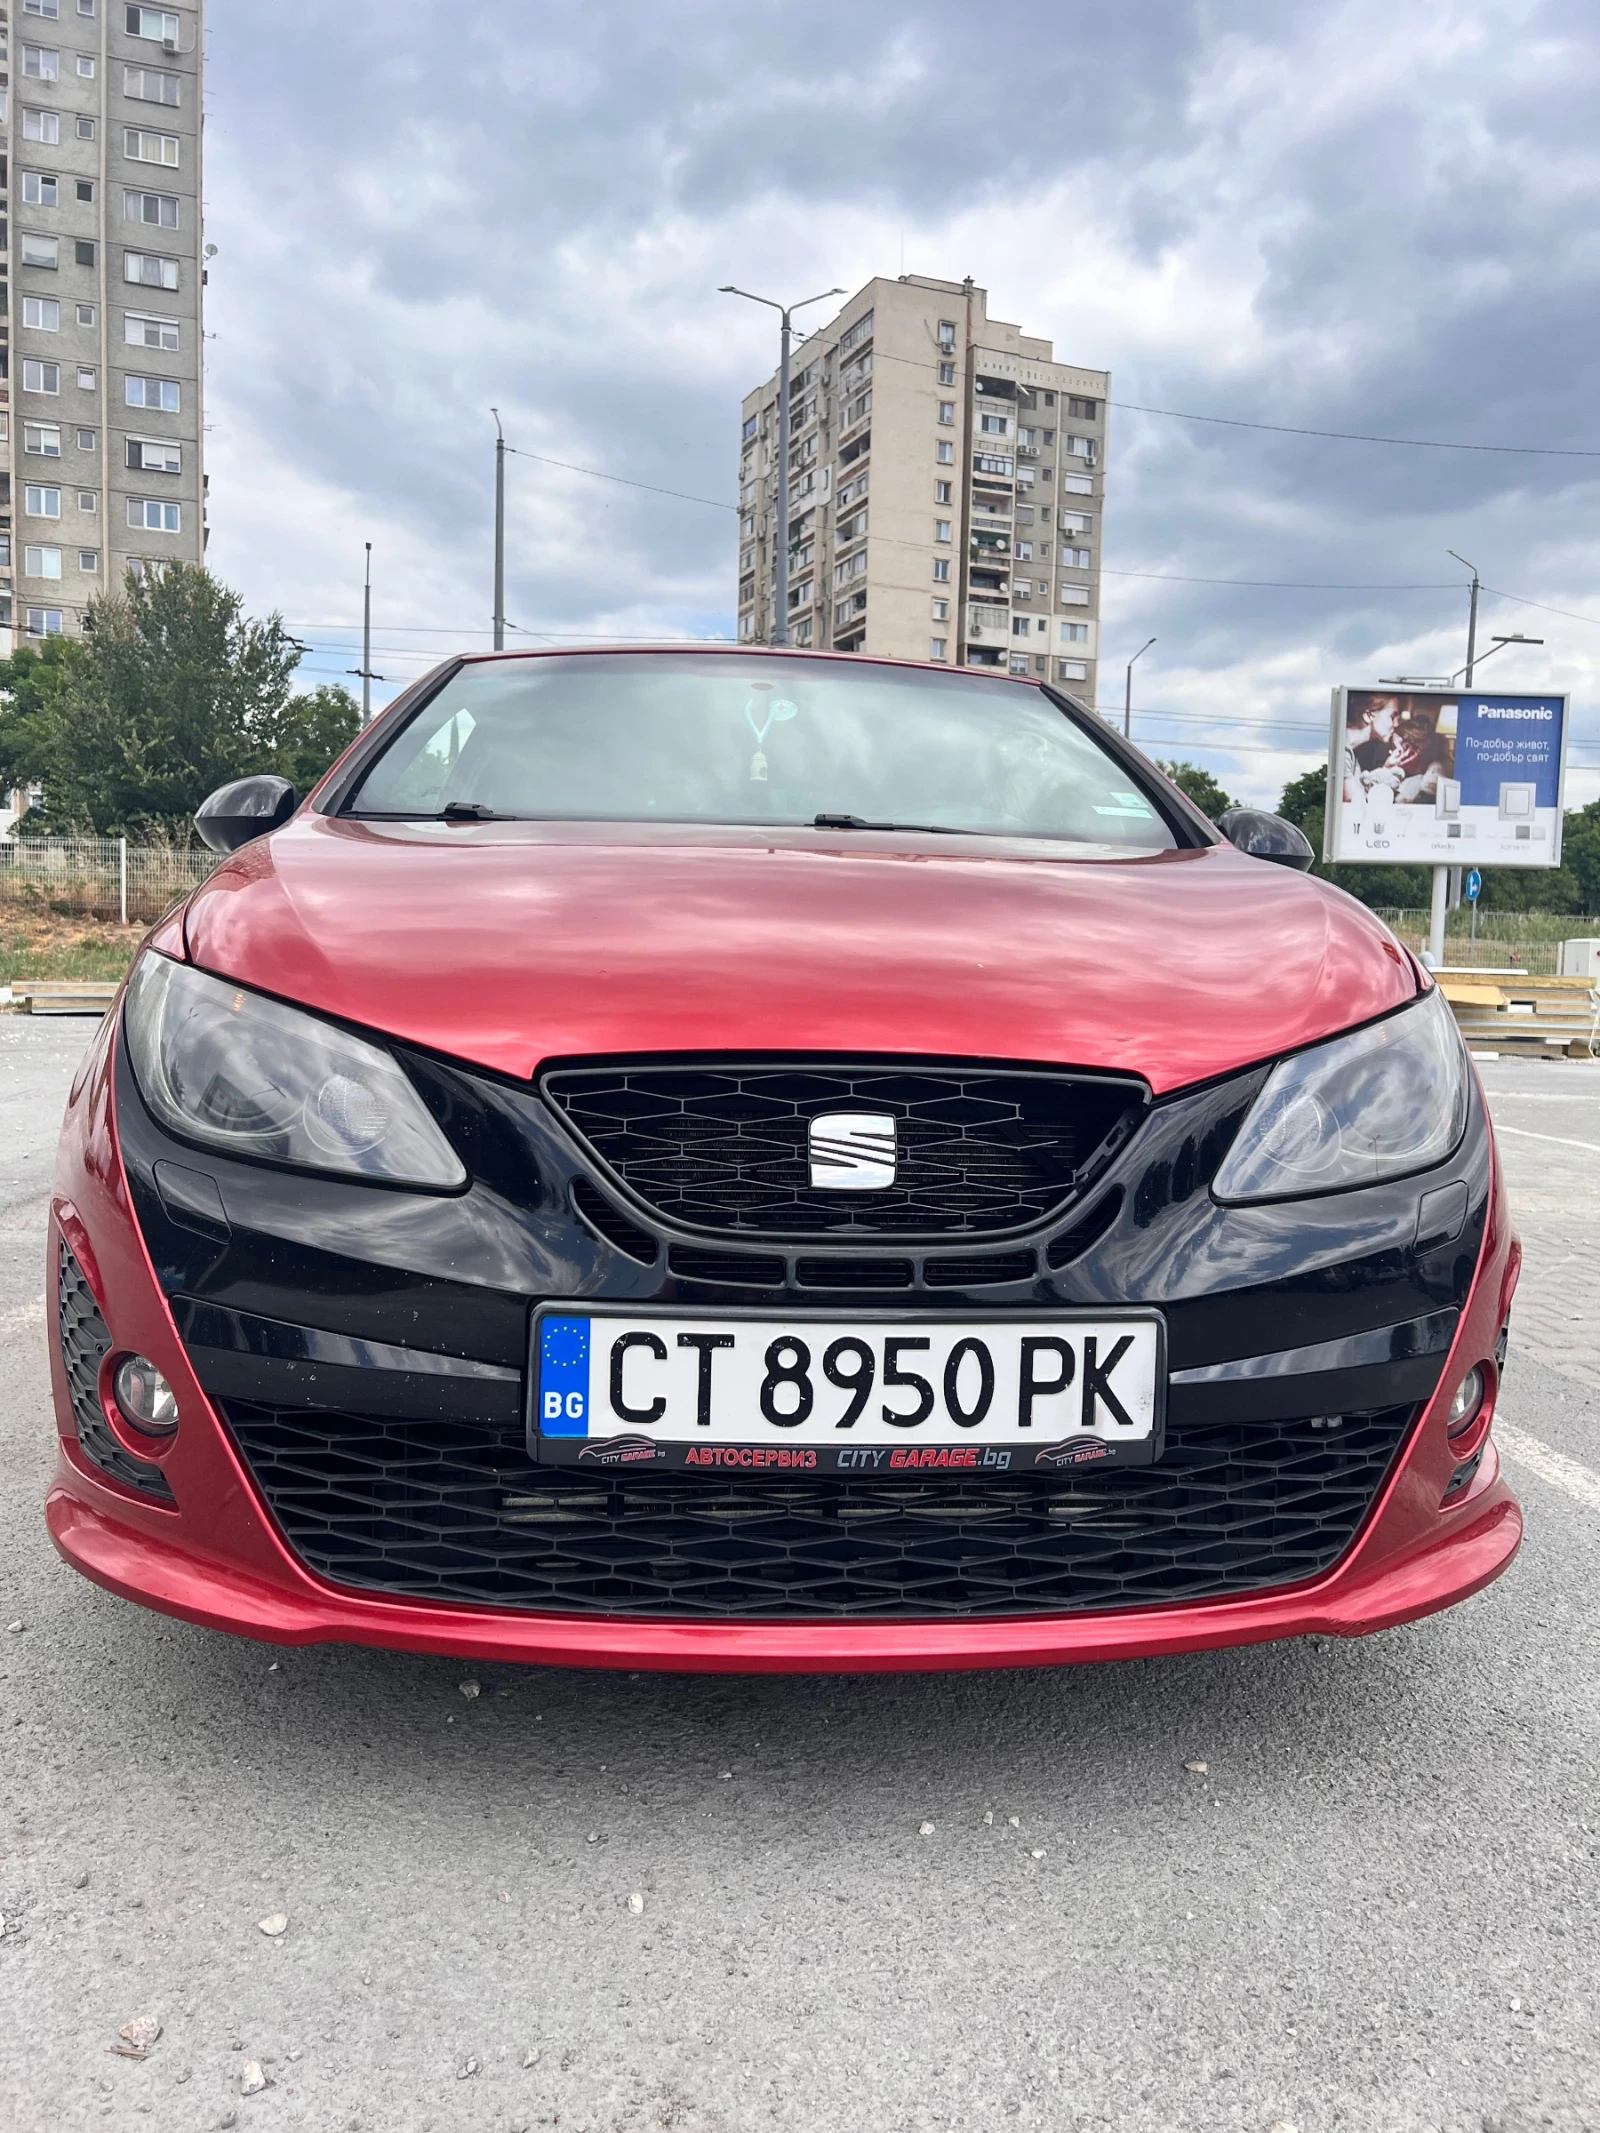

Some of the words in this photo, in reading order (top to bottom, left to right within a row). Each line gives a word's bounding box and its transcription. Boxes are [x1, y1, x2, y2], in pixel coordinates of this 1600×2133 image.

[1477, 704, 1552, 720] Panasonic
[1465, 737, 1514, 750] По-добър
[1516, 740, 1550, 751] живот,
[1477, 751, 1524, 764] по-добър
[1526, 753, 1549, 763] свят
[609, 1331, 735, 1426] CT
[759, 1335, 995, 1428] 8950
[1018, 1335, 1135, 1427] PK
[543, 1391, 584, 1419] BG
[601, 1455, 620, 1464] CITY
[684, 1447, 817, 1468] АВТОСЕРВИЗ
[836, 1450, 886, 1468] CITY
[889, 1448, 1012, 1470] GARAGE.bg
[1056, 1456, 1073, 1466] CITY
